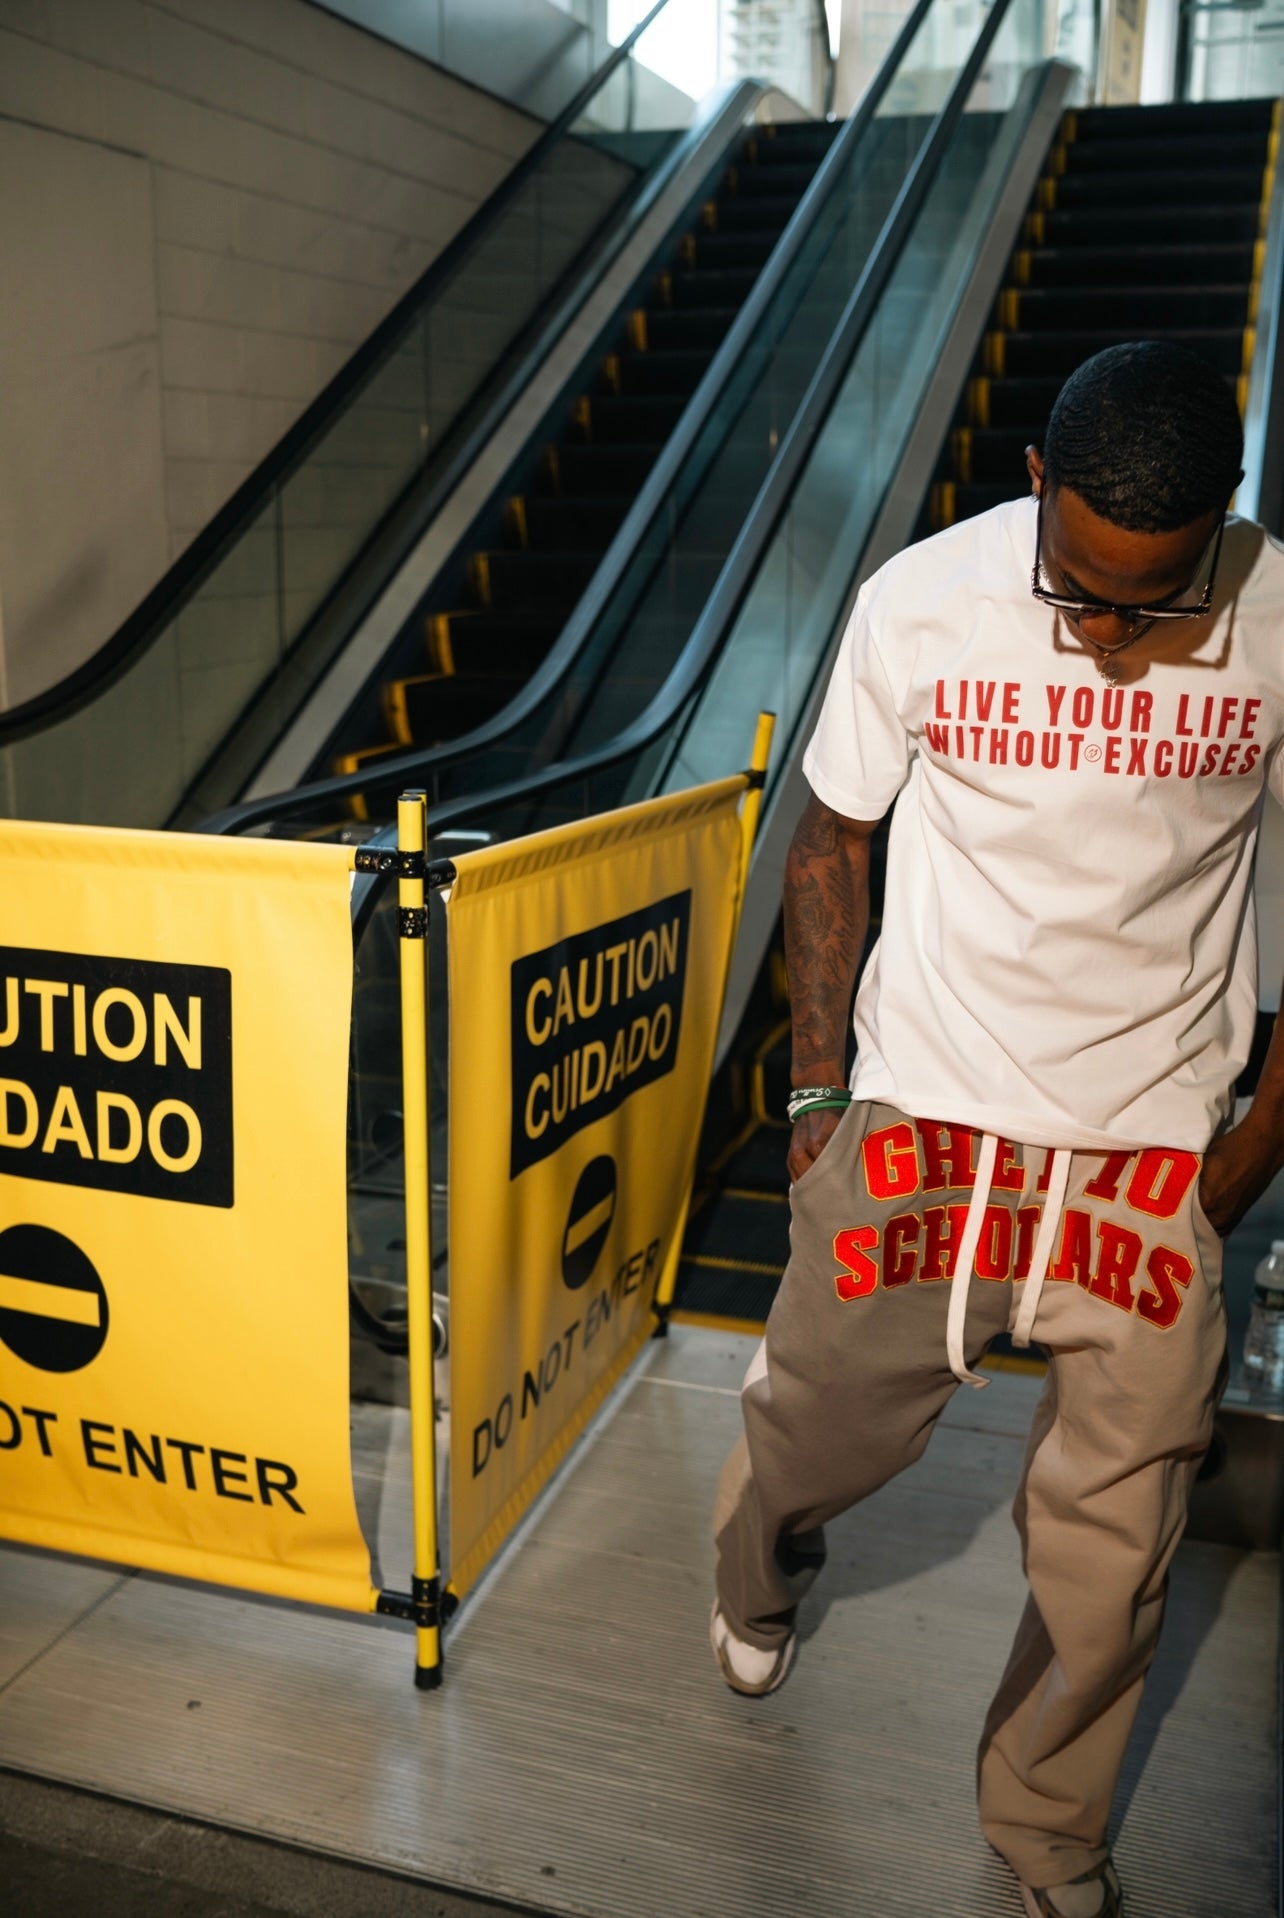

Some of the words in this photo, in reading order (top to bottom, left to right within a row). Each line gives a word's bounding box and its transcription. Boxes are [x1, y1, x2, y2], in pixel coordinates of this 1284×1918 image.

[925, 722, 1085, 771] WITHOUT
[1103, 736, 1262, 779] EXCUSES
[935, 679, 1021, 724] LIVE
[1046, 685, 1154, 733] YOUR
[1175, 694, 1262, 740] LIFE
[525, 917, 680, 1046] CAUTION
[524, 1002, 671, 1140] CUIDADO
[862, 1118, 1201, 1220] GHEO
[833, 1203, 1195, 1330] SCHOLARS
[472, 1392, 514, 1480] DO
[521, 1318, 580, 1420] NOT
[583, 1236, 661, 1350] ENTER
[80, 1418, 307, 1516] ENTER
